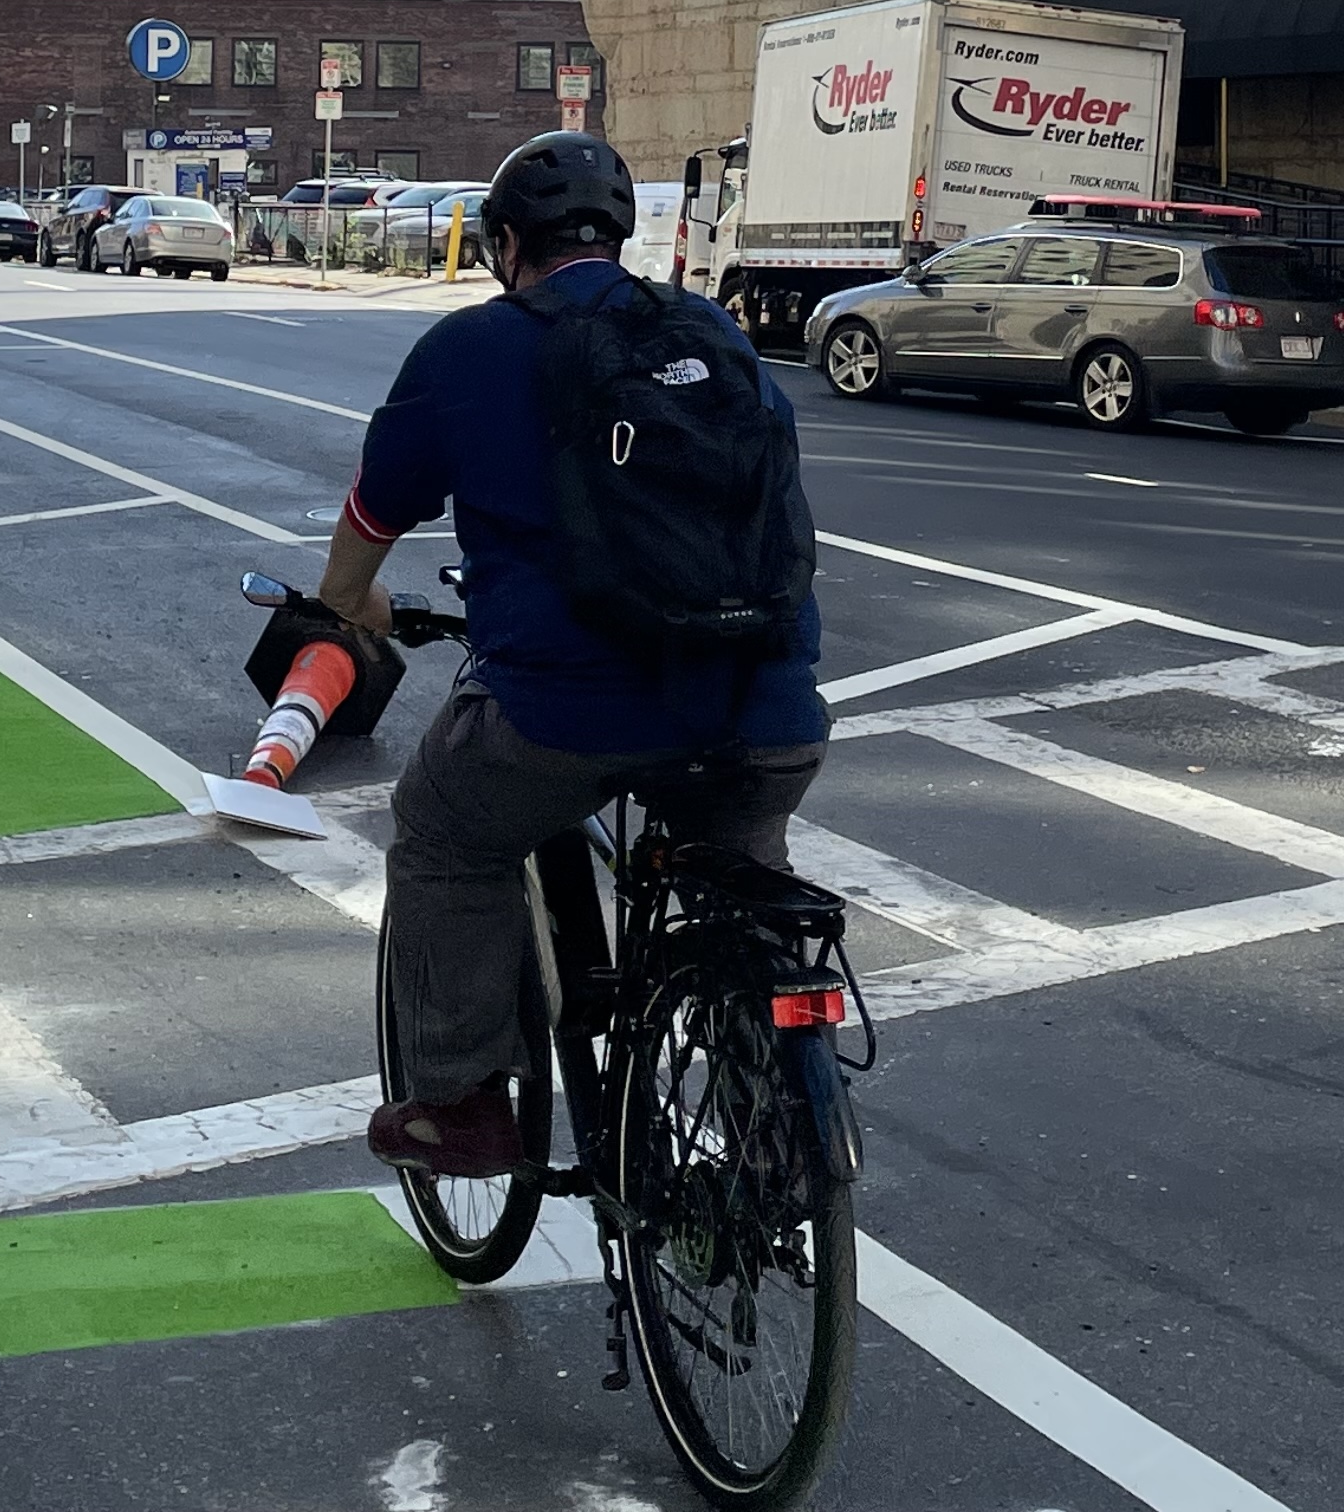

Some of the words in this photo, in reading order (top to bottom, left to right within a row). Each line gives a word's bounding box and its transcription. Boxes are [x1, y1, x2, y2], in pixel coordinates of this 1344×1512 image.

[148, 29, 180, 72] P
[954, 40, 1040, 66] Ryder.com
[829, 60, 894, 118] Ryder
[993, 77, 1132, 127] Ryder
[848, 110, 868, 134] Ever
[174, 135, 199, 145] OPEN
[212, 134, 244, 144] HOURS
[1042, 123, 1086, 145] Ever
[1087, 128, 1145, 152] better.
[944, 160, 972, 174] USED
[974, 163, 1014, 178] TRUCKS
[942, 181, 977, 195] Rental
[1069, 174, 1102, 189] TRUCK
[1103, 178, 1141, 193] RENTAL
